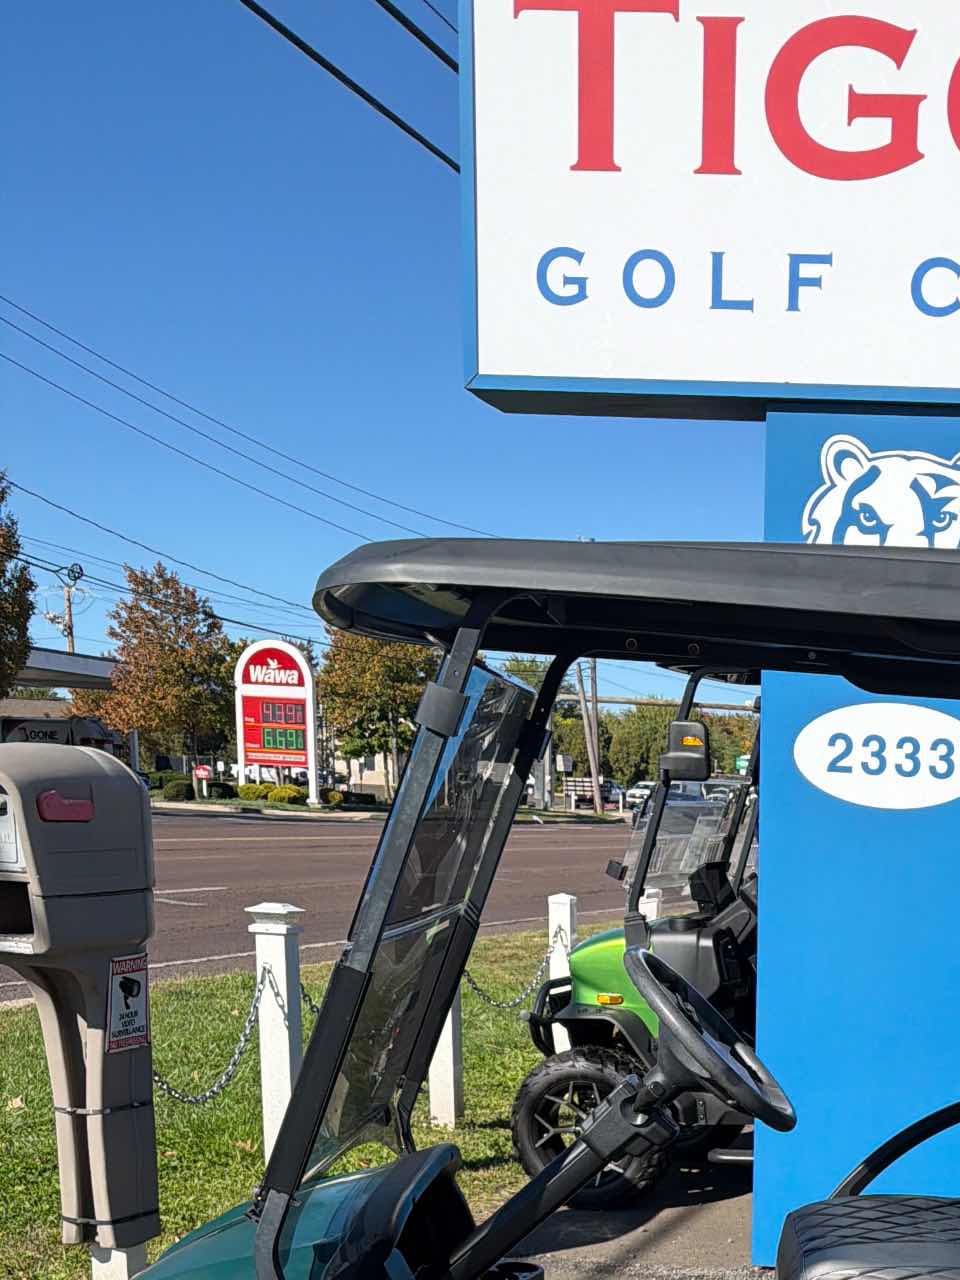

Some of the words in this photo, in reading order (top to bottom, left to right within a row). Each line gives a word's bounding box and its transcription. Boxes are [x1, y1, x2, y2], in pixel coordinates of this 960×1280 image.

[535, 246, 833, 313] GOLF
[249, 664, 299, 685] Wawa
[826, 732, 955, 780] 2333
[112, 958, 147, 975] WARNING
